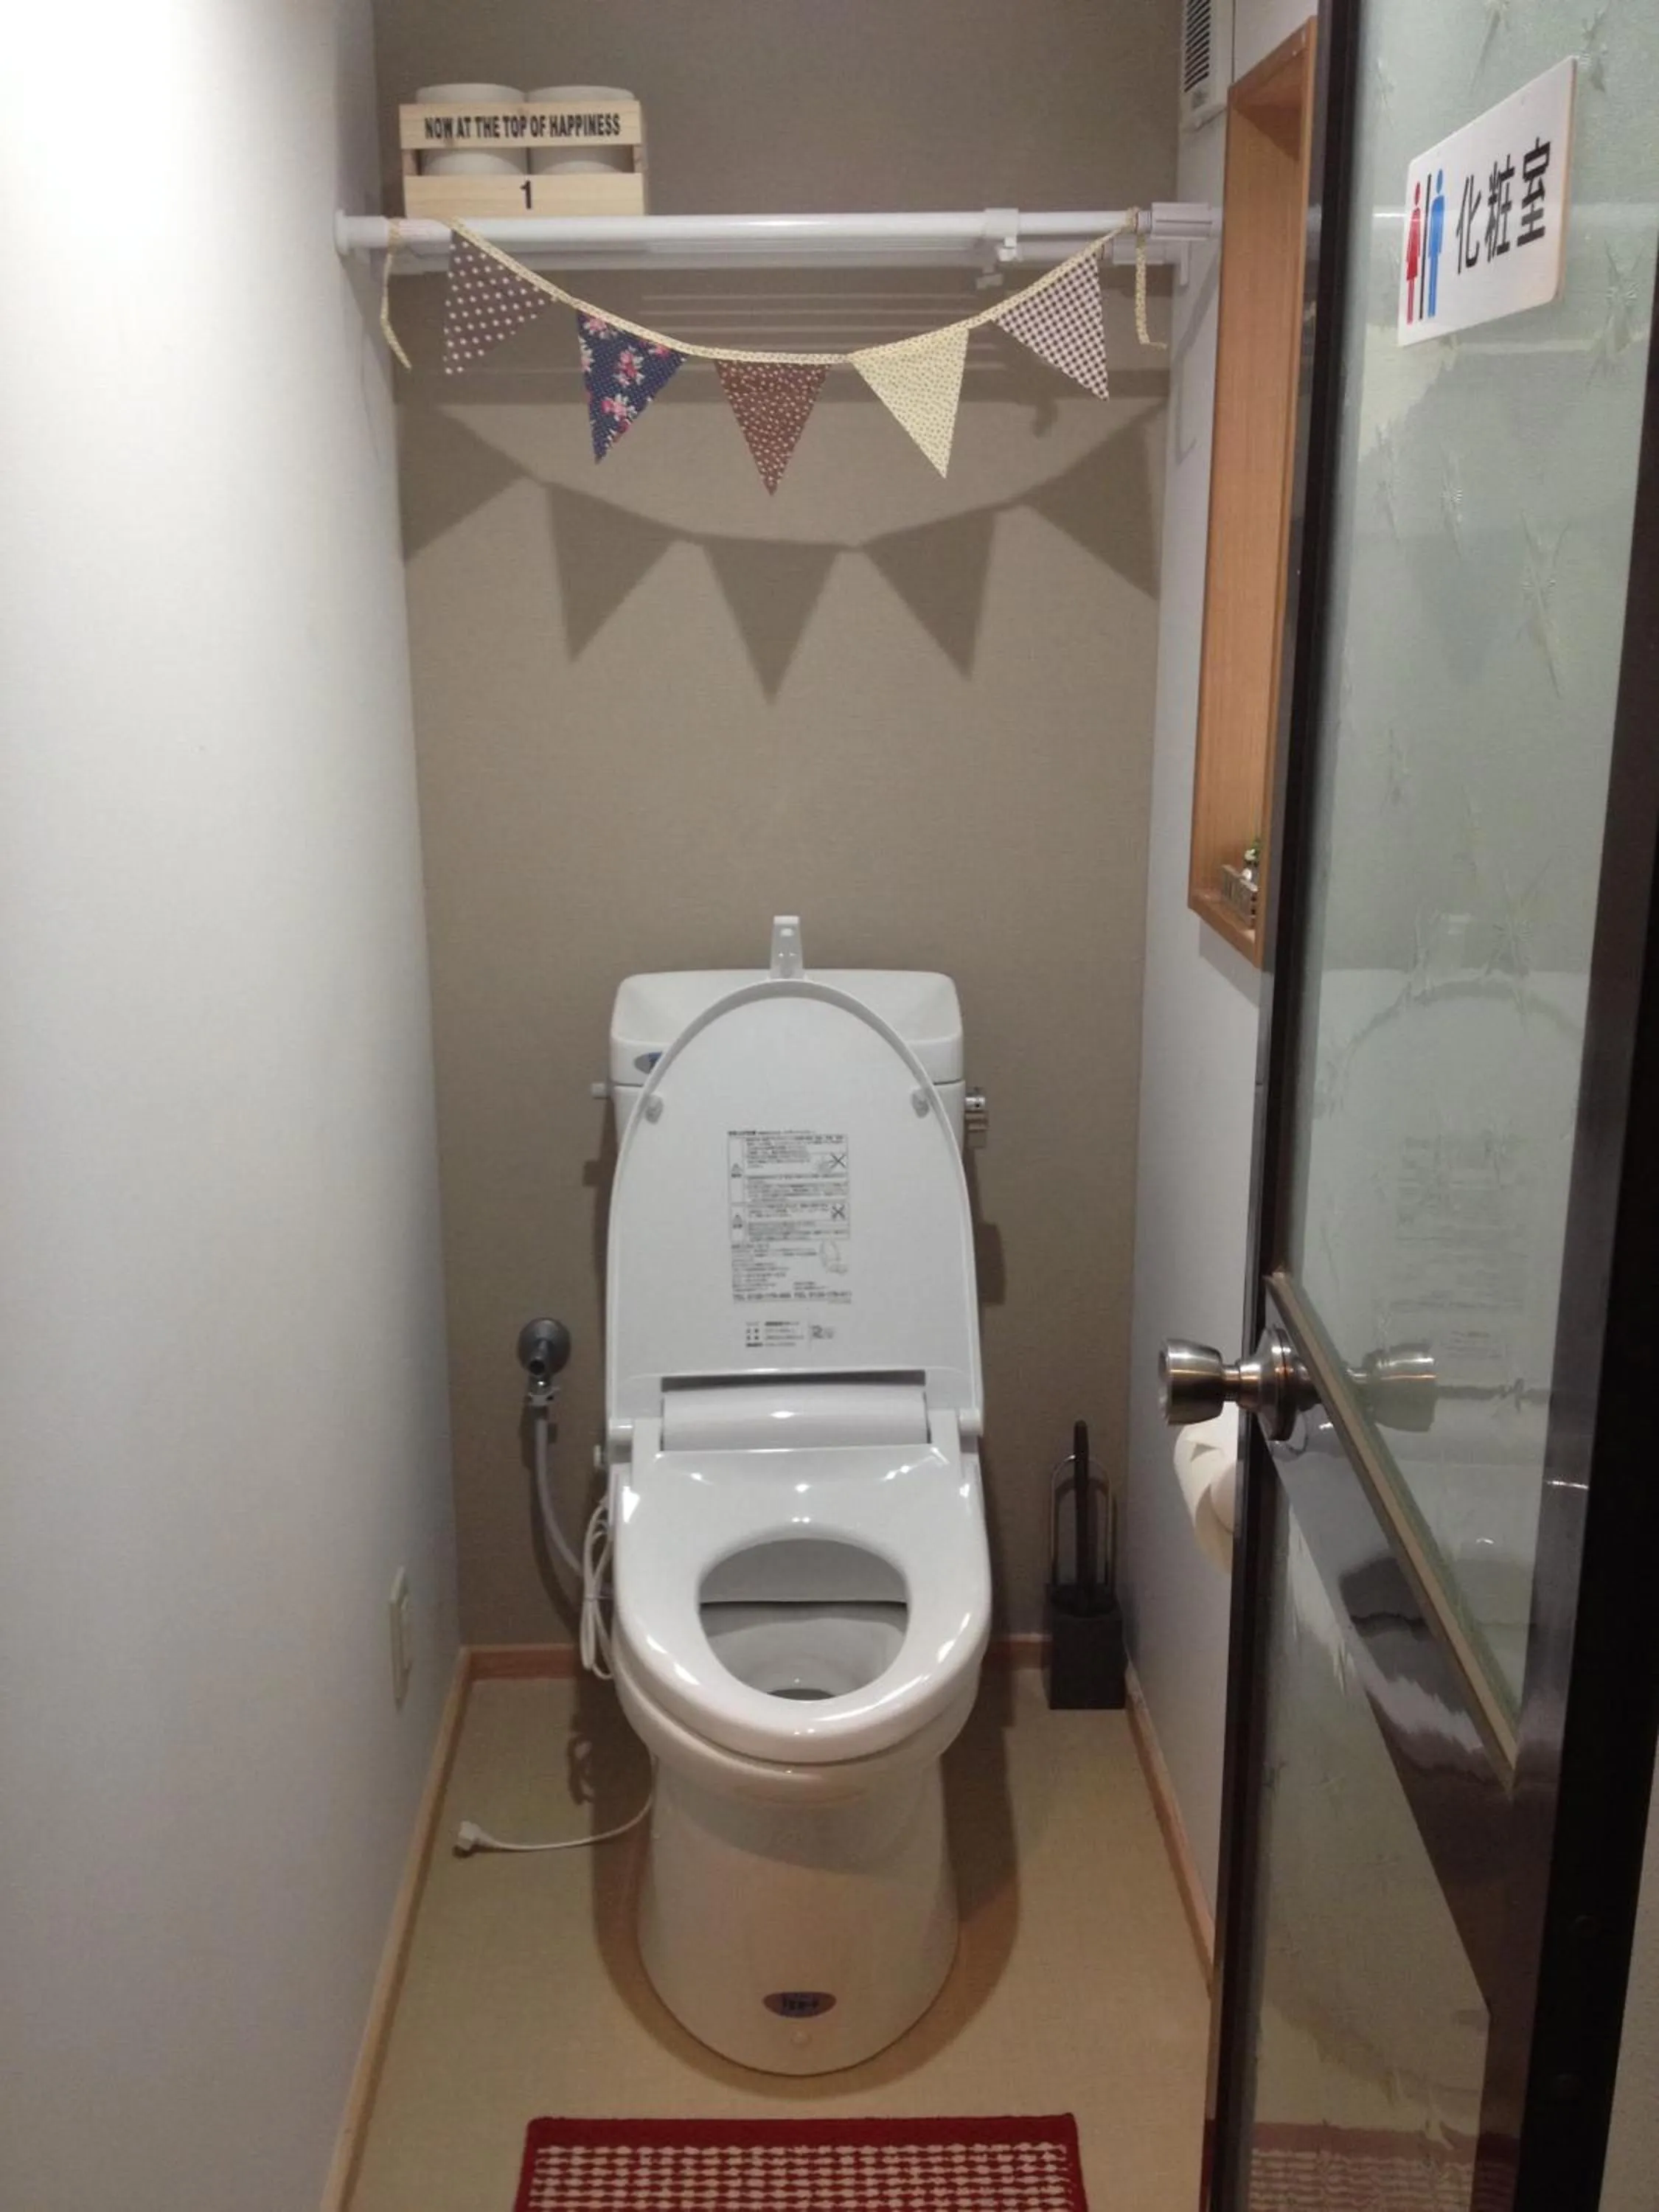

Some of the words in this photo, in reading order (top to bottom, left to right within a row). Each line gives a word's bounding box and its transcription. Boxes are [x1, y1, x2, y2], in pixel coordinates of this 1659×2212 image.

[424, 117, 452, 139] NOW
[456, 116, 471, 138] AT
[475, 116, 500, 138] THE
[502, 114, 527, 137] TOP
[529, 115, 546, 137] OF
[549, 113, 621, 137] HAPPINESS
[520, 180, 532, 209] 1
[1455, 137, 1551, 275] 化粧室
